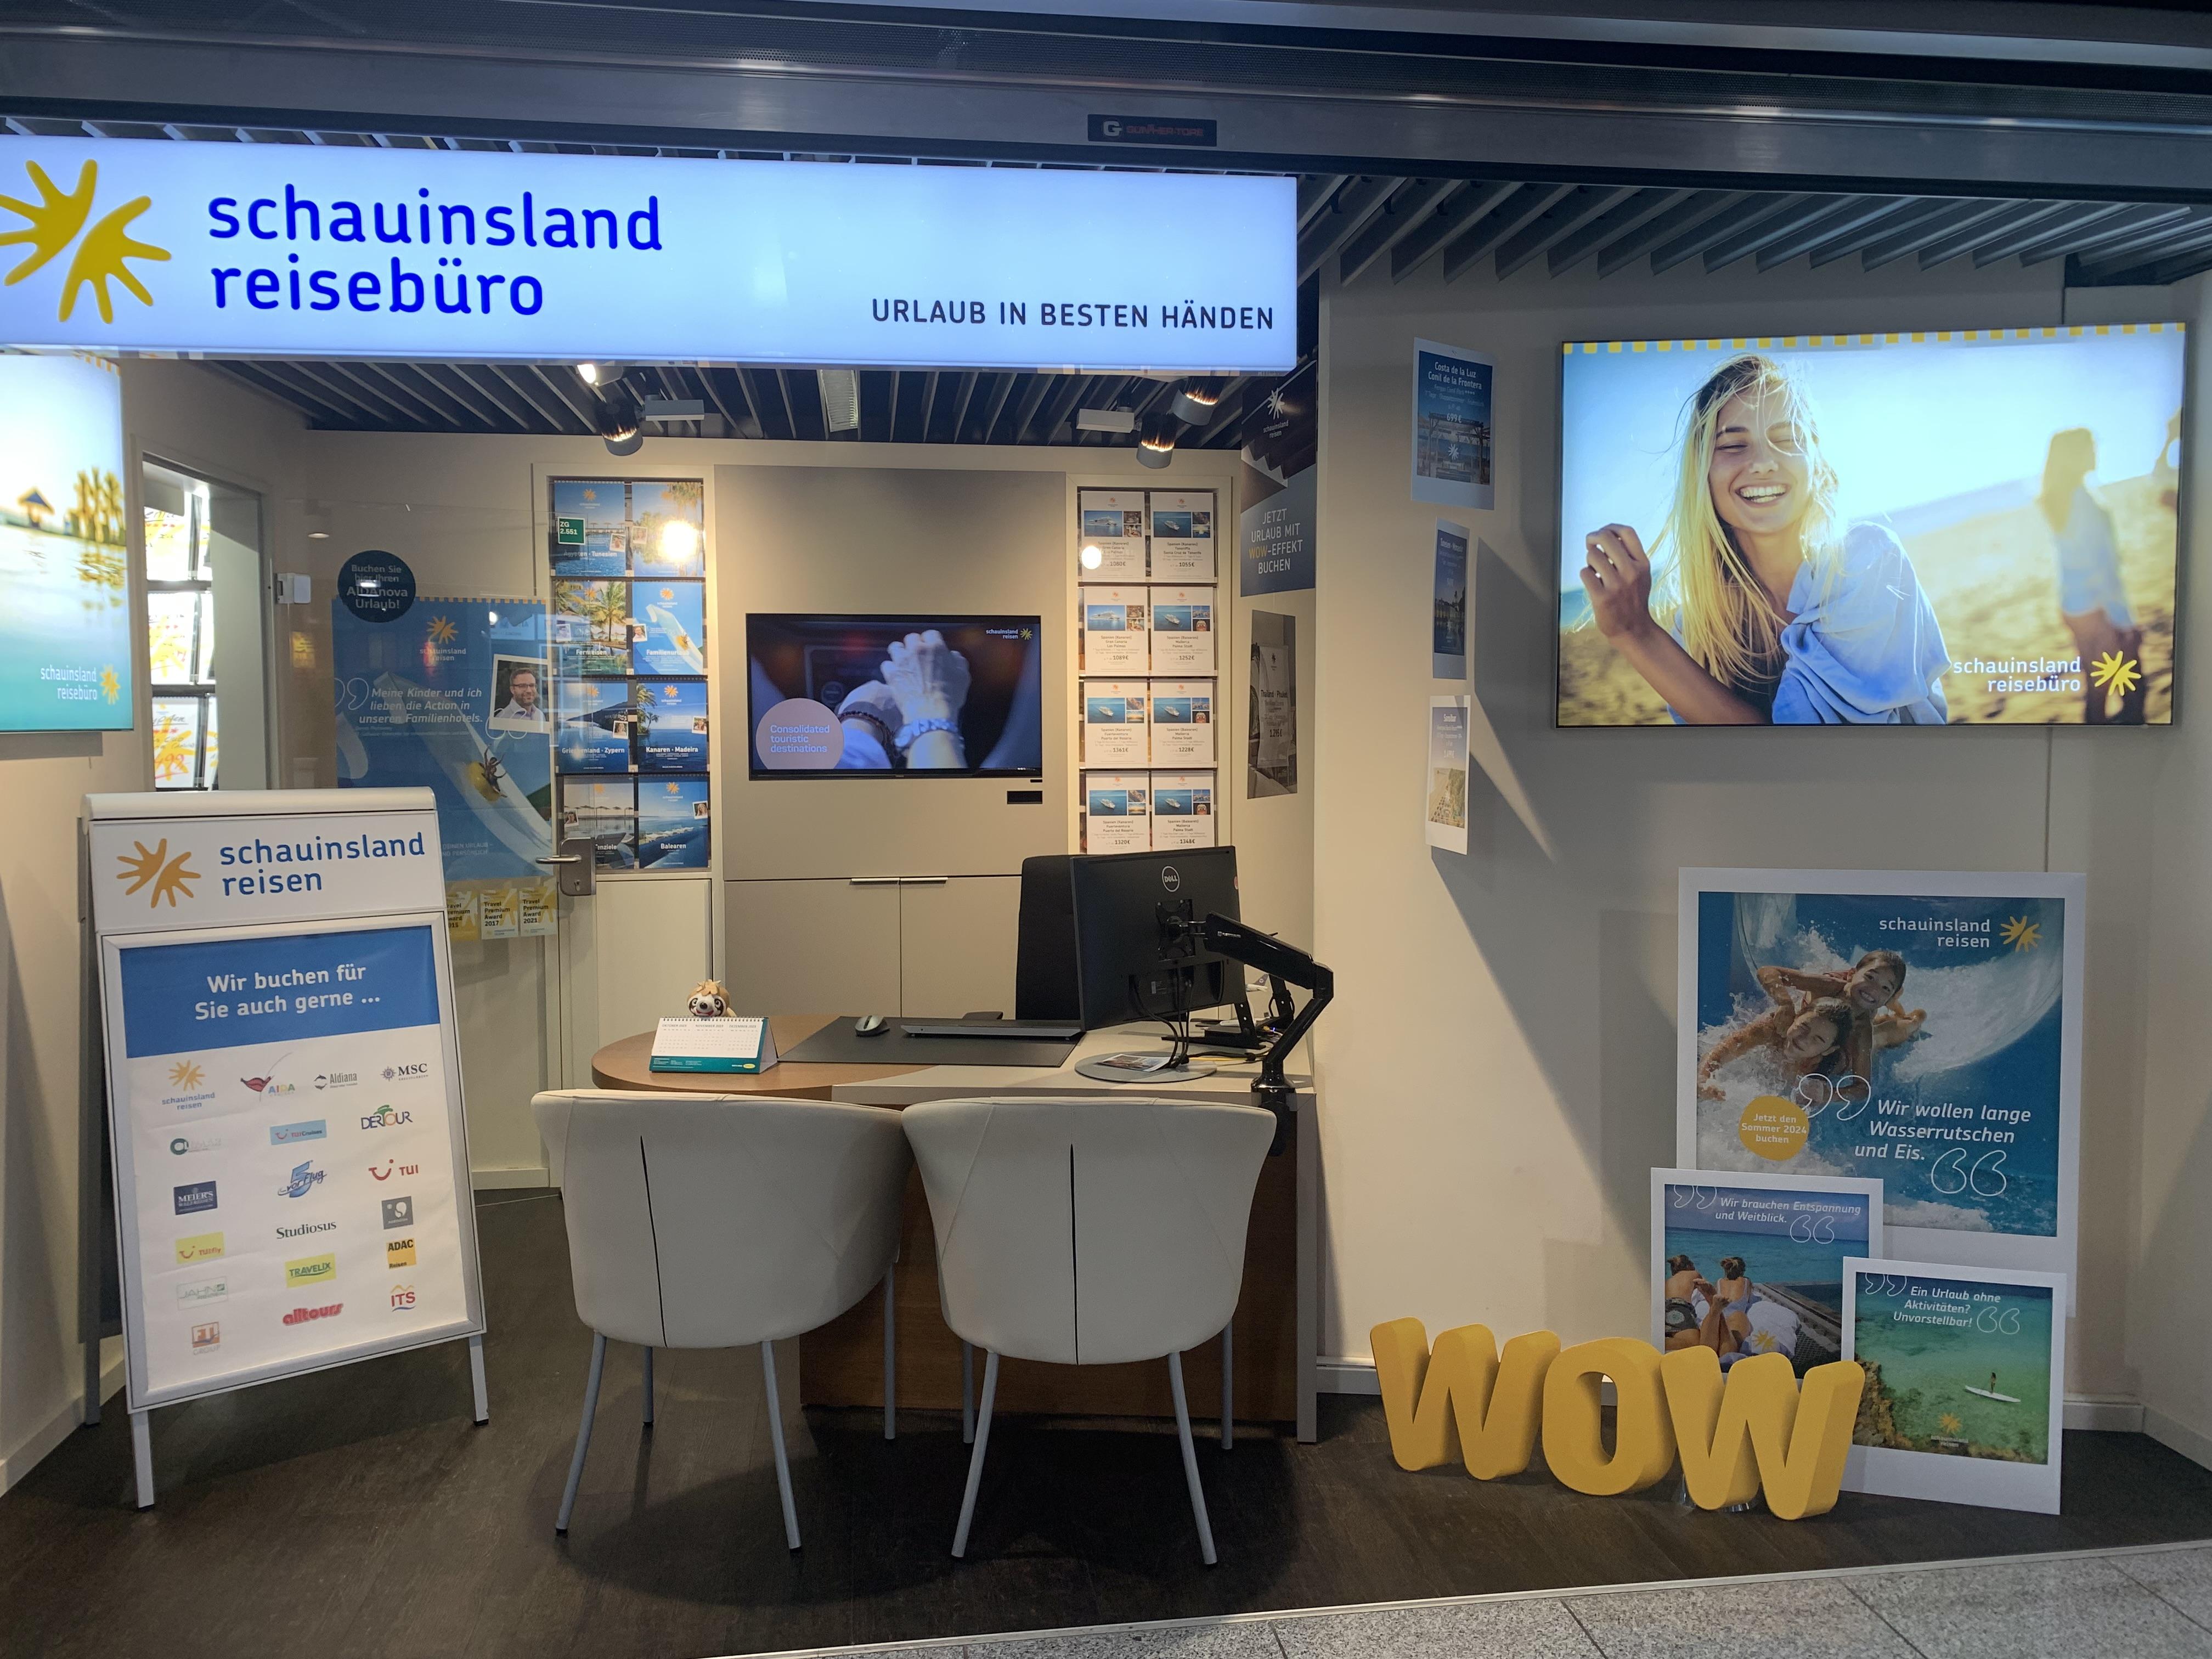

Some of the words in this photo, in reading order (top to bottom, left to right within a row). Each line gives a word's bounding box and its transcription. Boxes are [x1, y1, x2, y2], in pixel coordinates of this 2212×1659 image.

[208, 183, 663, 250] schauinsland
[211, 253, 544, 316] reisebüro
[872, 297, 986, 325] URLAUB
[1000, 302, 1026, 326] IN
[1041, 303, 1148, 329] BESTEN
[1161, 300, 1273, 330] HÄNDEN
[1435, 362, 1449, 373] Costa
[1451, 365, 1458, 374] de
[1460, 367, 1465, 376] la
[1466, 369, 1476, 378] Luz
[1428, 371, 1442, 382] Conil
[1443, 375, 1450, 383] de
[1458, 377, 1482, 390] Frontera
[1263, 419, 1289, 433] schauinsland
[1269, 430, 1282, 438] reisen
[1262, 508, 1287, 524] JETZT
[1251, 526, 1282, 543] URLAUB
[1284, 523, 1300, 537] MIT
[1249, 539, 1304, 560] WOW-EFFEKT
[1258, 558, 1290, 574] BUCHEN
[347, 586, 408, 597] AIDAnova
[356, 599, 399, 608] Urlaub!
[41, 664, 97, 682] schauinsland
[1953, 656, 2081, 674] schauinsland
[57, 684, 97, 700] reisebüro
[371, 689, 404, 697] Meine
[407, 689, 441, 697] Kinder
[444, 688, 464, 697] und
[467, 688, 482, 697] ich
[1988, 676, 2081, 693] reisebüro
[370, 701, 402, 710] lieben
[406, 701, 422, 710] die
[424, 701, 457, 710] Action
[461, 701, 470, 710] in
[359, 715, 402, 724] unseren
[406, 714, 483, 723] Familienhotels.
[770, 725, 830, 733] Consolidated
[771, 744, 827, 753] destinations
[220, 832, 426, 866] schauinsland
[222, 869, 323, 896] reisen
[1879, 917, 1990, 933] schauinsland
[1937, 933, 1990, 948] reisen
[207, 975, 247, 993] Wir
[255, 969, 329, 989] buchen
[336, 963, 366, 981] für
[195, 1002, 229, 1020] Sie
[237, 995, 287, 1017] auch
[295, 992, 353, 1014] gerne
[398, 1063, 428, 1076] MSC
[330, 1072, 357, 1084] Aldiana
[268, 1084, 295, 1094] AIDA
[162, 1092, 215, 1105] schauinsland
[177, 1102, 202, 1110] reisen
[361, 1108, 413, 1130] DERTOUR
[1753, 1114, 1776, 1124] Jetzt
[1779, 1115, 1797, 1124] den
[1877, 1099, 1910, 1116] Wir
[1915, 1103, 1974, 1120] wollen
[1981, 1105, 2032, 1123] lange
[1741, 1123, 1781, 1133] Sommer
[1783, 1125, 1807, 1135] 2024
[1869, 1121, 2016, 1144] Wasserrutschen
[1756, 1133, 1789, 1144] buchen
[1854, 1144, 1888, 1158] und
[1894, 1144, 1926, 1161] Eis.
[399, 1165, 418, 1176] TUI
[1720, 1198, 1739, 1207] Wir
[1742, 1199, 1790, 1210] brauchen
[1793, 1202, 1861, 1216] Entspannung
[1715, 1211, 1735, 1221] und
[1737, 1212, 1787, 1223] Weitblick.
[276, 1221, 337, 1239] Studiosus
[388, 1239, 414, 1251] ADAC
[289, 1262, 330, 1277] TRAVELIX
[391, 1292, 415, 1307] ITS
[1910, 1286, 1928, 1296] Ein
[1932, 1288, 1970, 1300] Urlaub
[1973, 1292, 2001, 1303] ohne
[283, 1303, 343, 1327] alltours
[1904, 1300, 1971, 1314] Aktivitäten?
[1893, 1312, 1973, 1328] Unvorstellbar!
[1370, 1317, 1866, 1521] WOW
